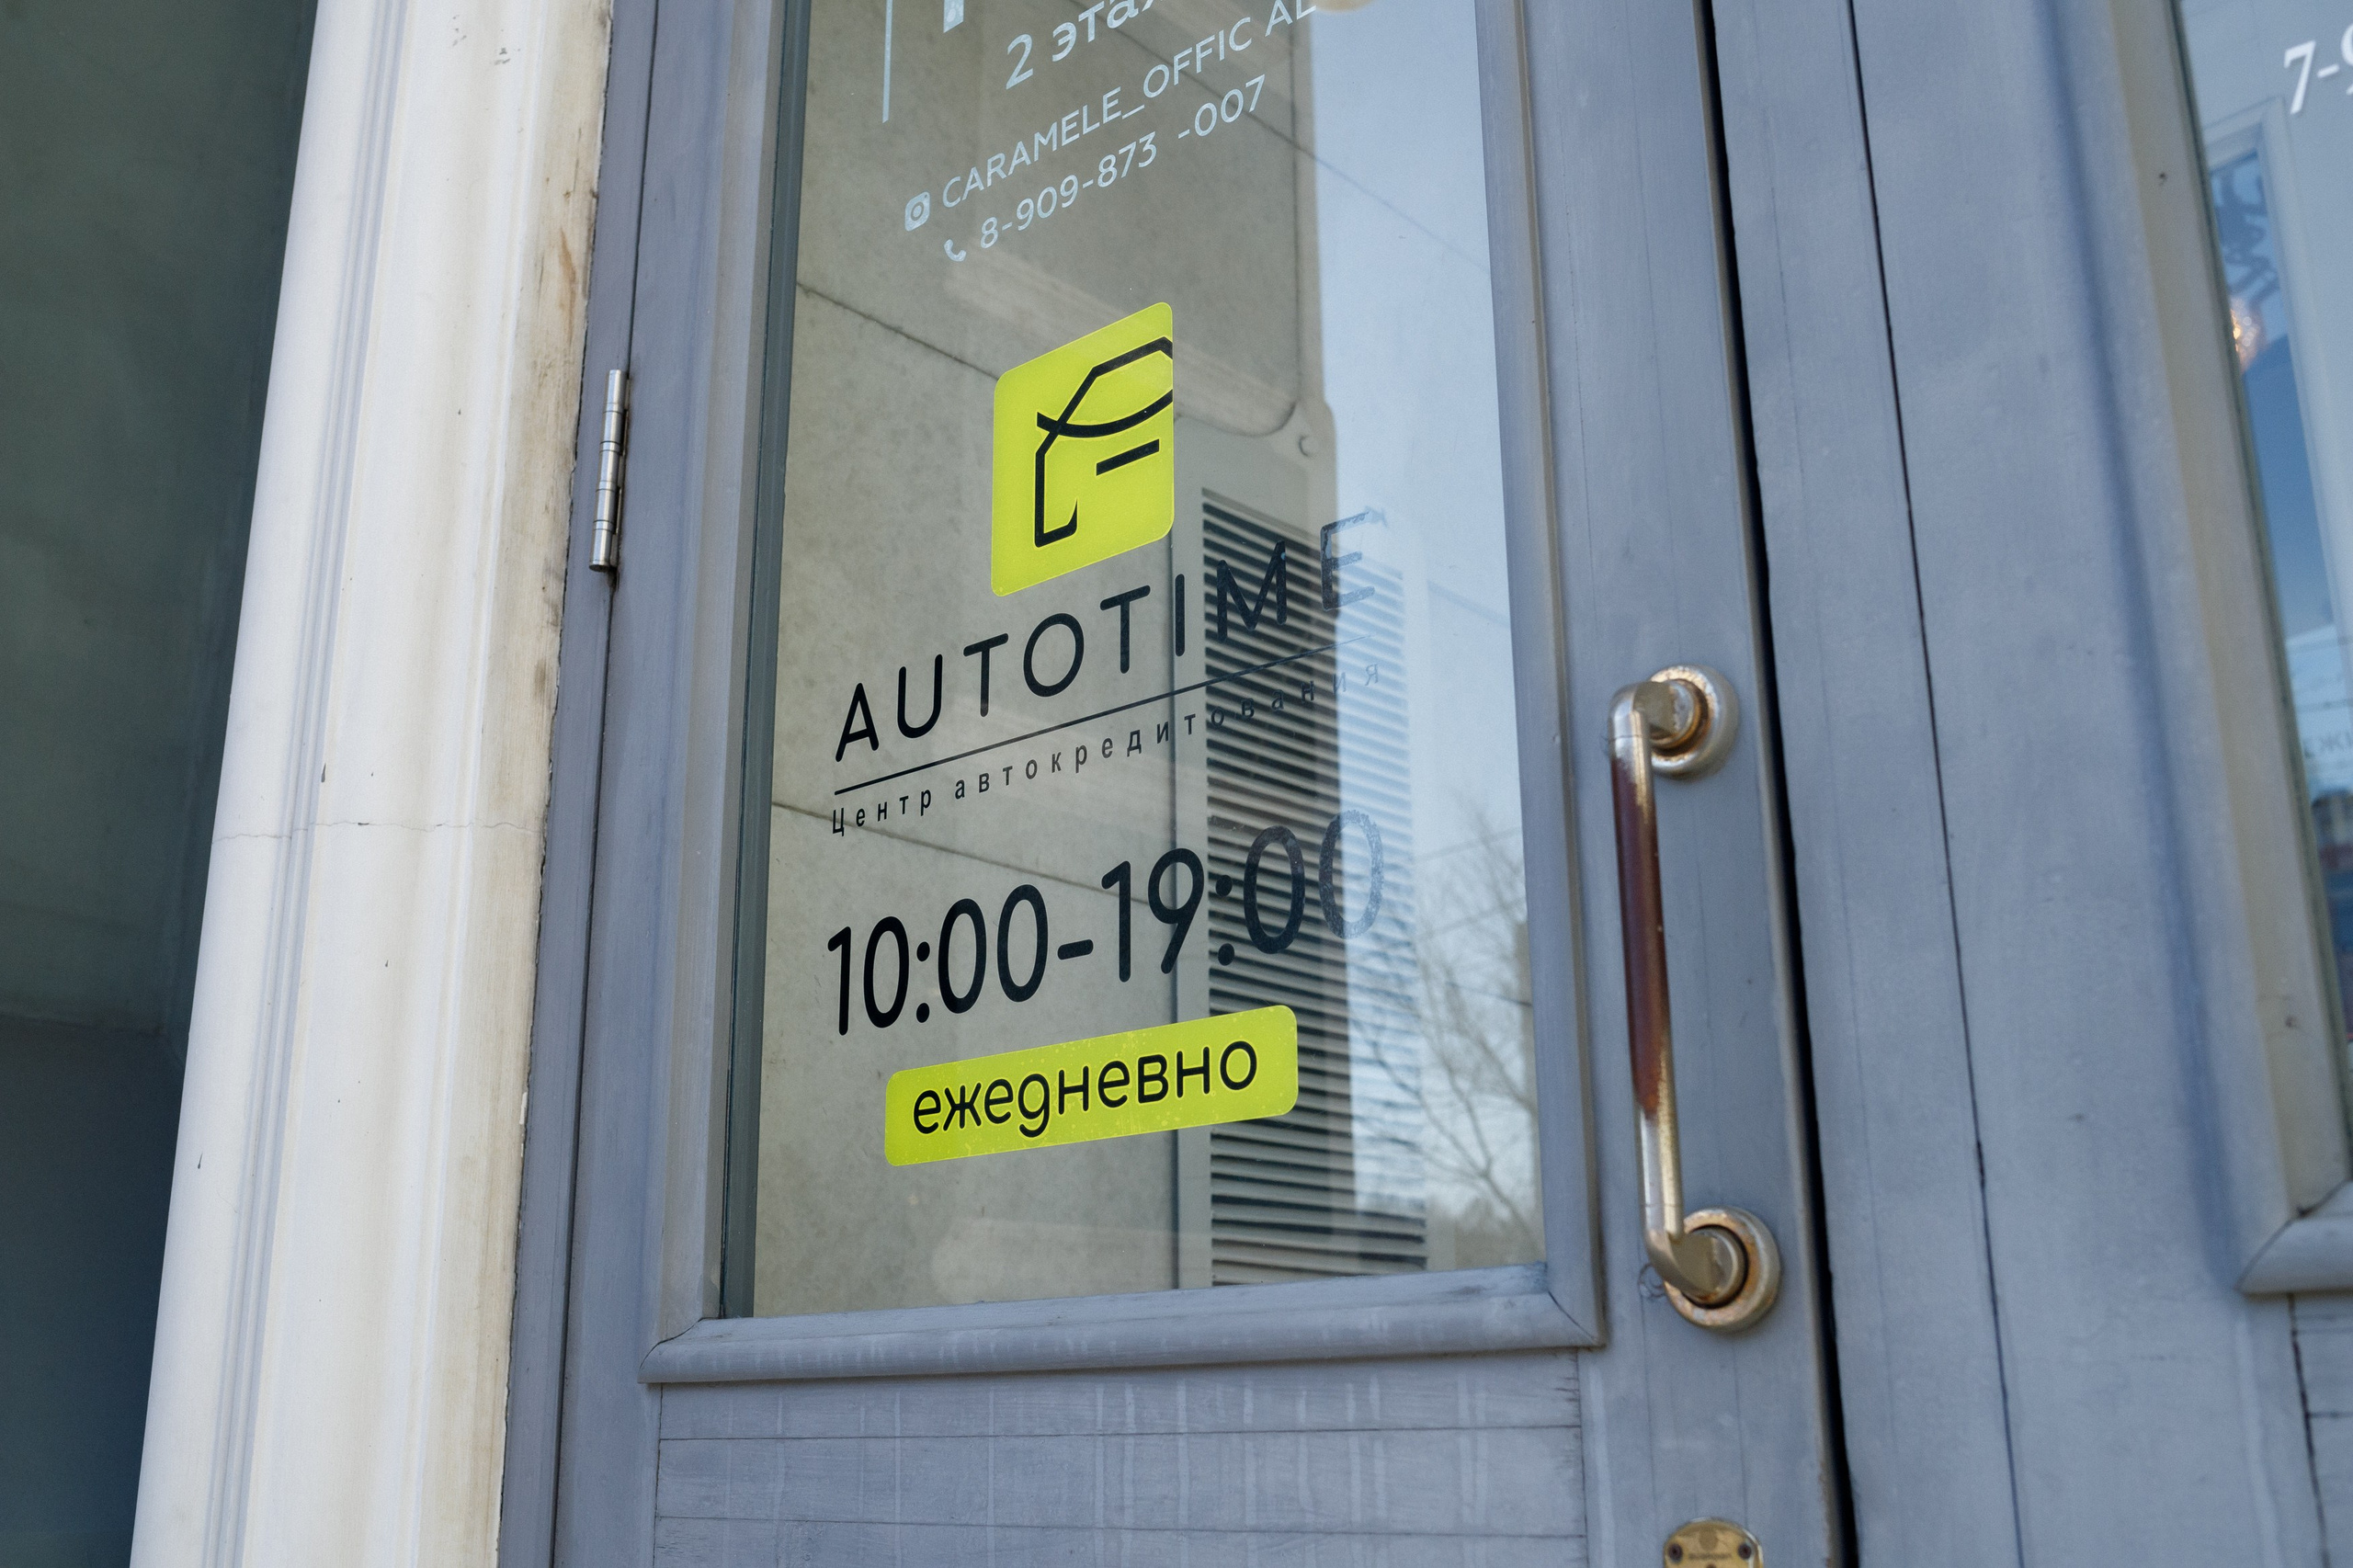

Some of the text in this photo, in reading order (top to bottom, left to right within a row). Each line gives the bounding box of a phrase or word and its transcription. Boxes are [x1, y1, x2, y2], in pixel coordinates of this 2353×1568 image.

[1006, 0, 1163, 90] 2 эта
[835, 510, 1376, 762] AUTOTIME
[832, 663, 1379, 836] Центр автокредитования
[827, 809, 1382, 1036] 10:00-19:00
[913, 1040, 1257, 1138] ежедневно
